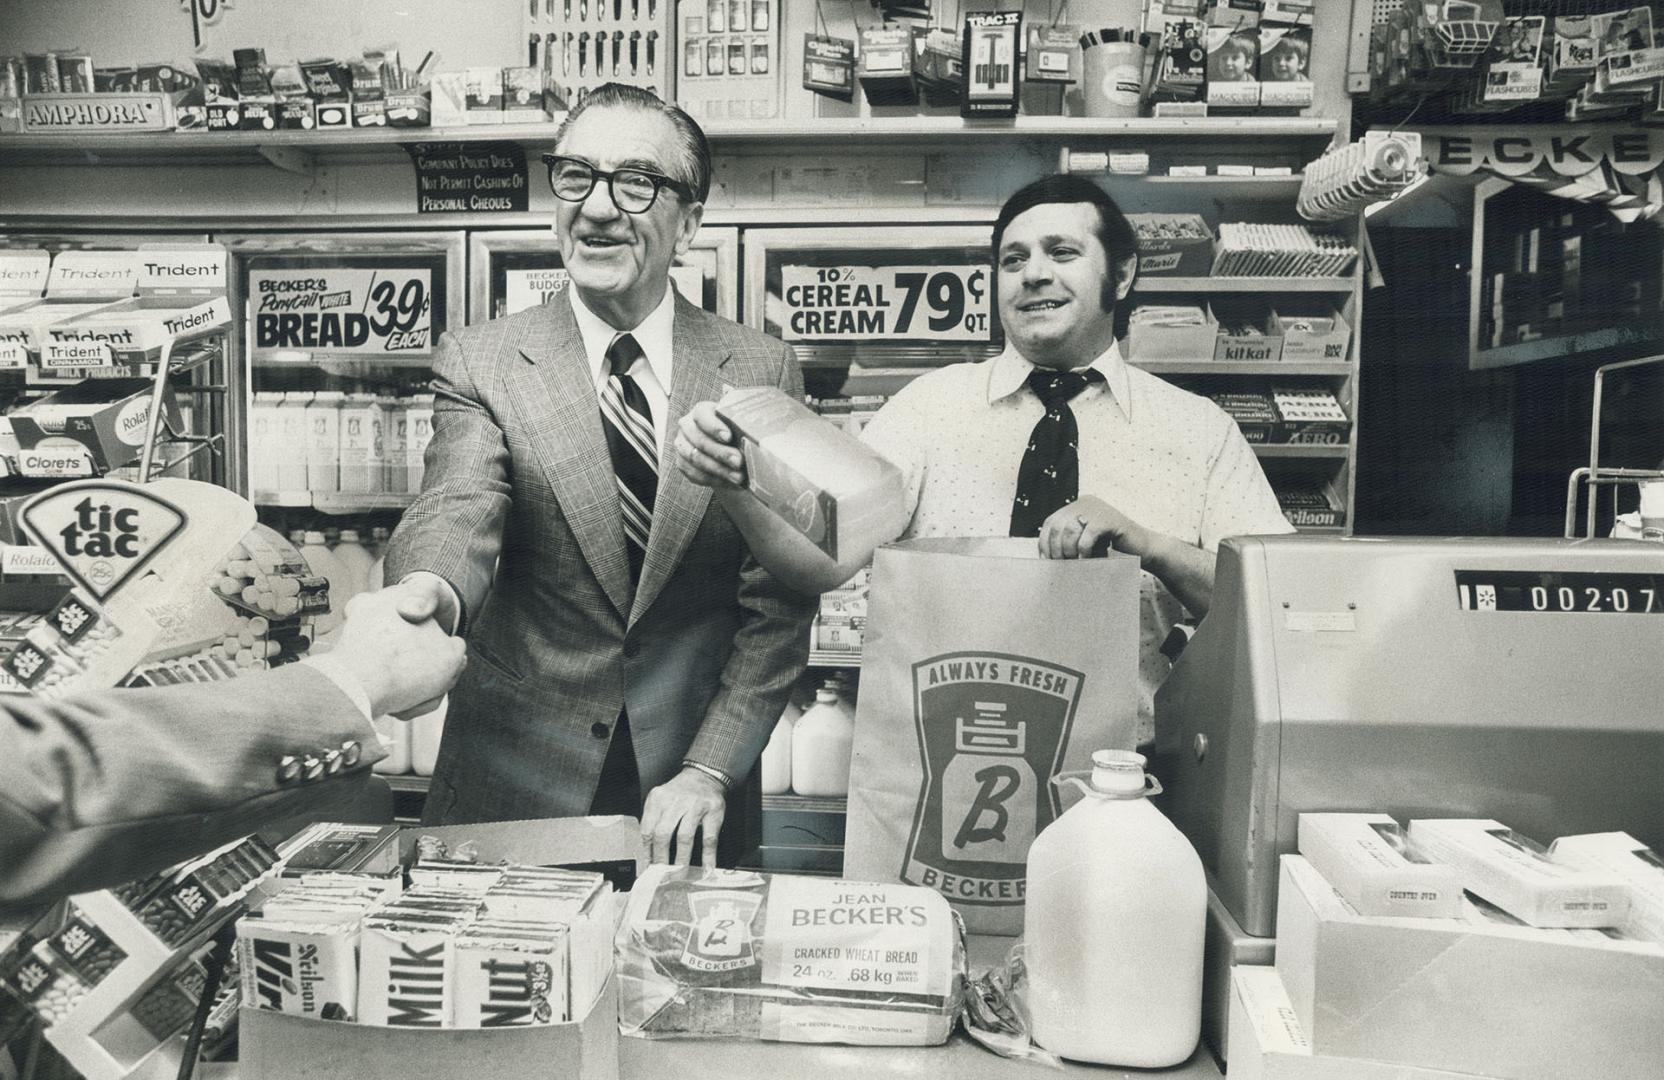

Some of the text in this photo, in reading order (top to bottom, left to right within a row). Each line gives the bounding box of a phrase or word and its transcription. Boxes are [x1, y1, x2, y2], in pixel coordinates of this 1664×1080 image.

[968, 15, 1003, 27] TRAC
[28, 103, 148, 126] AMPHORA
[418, 154, 514, 170] COMPANY POLICY DOES
[422, 176, 437, 190] NOT
[440, 175, 471, 190] PERMIT
[474, 174, 511, 189] CASHING
[422, 194, 512, 211] PERSONAL CHEQUES
[60, 267, 132, 279] Trident
[144, 263, 219, 276] Trident
[817, 268, 856, 283] 10%
[258, 279, 327, 292] BECKER'S
[258, 292, 349, 312] Ponytail WHITE
[786, 284, 890, 307] CEREAL
[163, 307, 215, 336] Trident
[257, 279, 430, 348] BREAD 39¢
[790, 310, 988, 334] CREAM QT.
[49, 328, 132, 343] Trident
[388, 332, 428, 350] EACH
[49, 346, 101, 358] Trident
[1289, 432, 1340, 444] AERO
[26, 456, 80, 469] Clorets
[74, 497, 139, 533] tic
[59, 521, 139, 559] tac
[928, 662, 1068, 695] ALWAYS FRESH
[953, 764, 1021, 849] B
[832, 894, 886, 904] JEAN
[792, 905, 927, 927] BECKER'S
[794, 947, 918, 963] CRACKED WHEAT BREAD
[298, 944, 325, 1012] Neilson
[793, 964, 812, 978] 24
[847, 968, 870, 982] .68
[874, 968, 892, 985] kg
[387, 942, 445, 1028] Milk
[480, 958, 532, 1028] Nut
